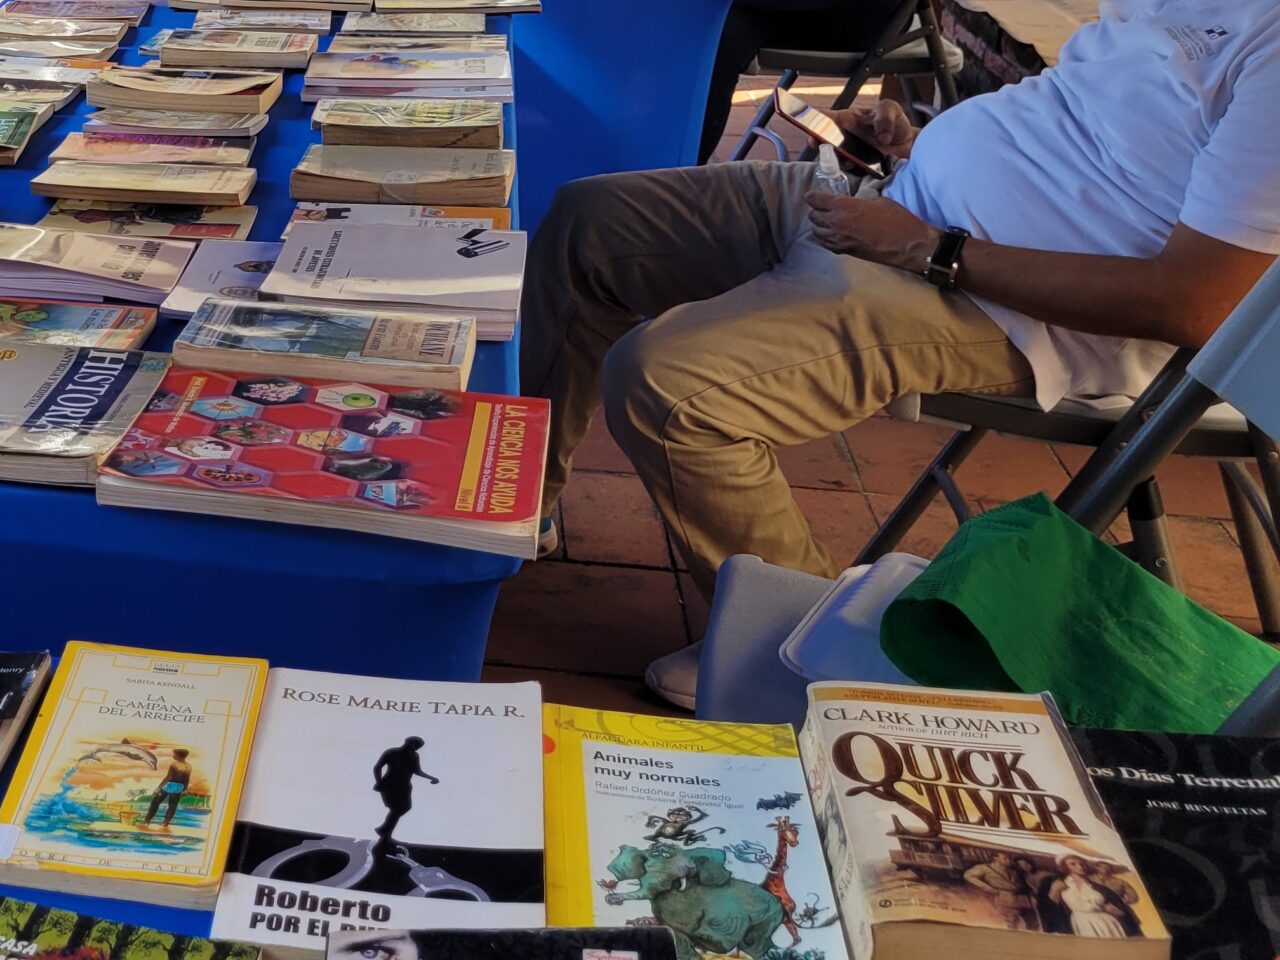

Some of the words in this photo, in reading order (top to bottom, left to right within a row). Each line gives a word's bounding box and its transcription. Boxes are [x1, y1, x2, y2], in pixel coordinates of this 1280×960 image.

[29, 349, 129, 433] HISTORIA
[504, 404, 528, 417] LA
[498, 420, 527, 457] CIENCIA
[494, 459, 520, 480] NOS
[488, 480, 518, 514] AYUDA
[126, 677, 156, 687] SARITA
[157, 681, 198, 690] KENDALL
[115, 699, 193, 714] CAMPANA
[146, 693, 167, 703] LA
[281, 687, 341, 705] ROSE
[347, 695, 422, 714] MARIE
[427, 701, 498, 717] TAPIA
[503, 705, 526, 719] R.
[98, 706, 128, 717] DEL
[131, 711, 207, 724] ARRECIFE
[823, 707, 915, 726] CLARK
[919, 714, 1042, 735] HOWARD
[581, 731, 649, 746] ALFAGUARA
[877, 724, 914, 732] AUTHOR
[929, 727, 960, 737] DIRT
[960, 730, 990, 739] RICH
[593, 750, 674, 770] Animales
[832, 730, 1046, 802] QUICK
[594, 766, 632, 781] muy
[638, 771, 722, 788] normales
[1087, 767, 1115, 778] os
[1118, 766, 1175, 784] Días
[595, 781, 629, 792] Rafael
[886, 778, 1090, 839] SILVER
[1145, 798, 1180, 810] JOSÉ
[1184, 803, 1268, 816] REVUELTAS
[19, 849, 70, 862] ORRE
[141, 863, 208, 876] PAPEL
[253, 883, 392, 923] Roberto
[249, 911, 302, 934] POR
[306, 917, 331, 938] EL
